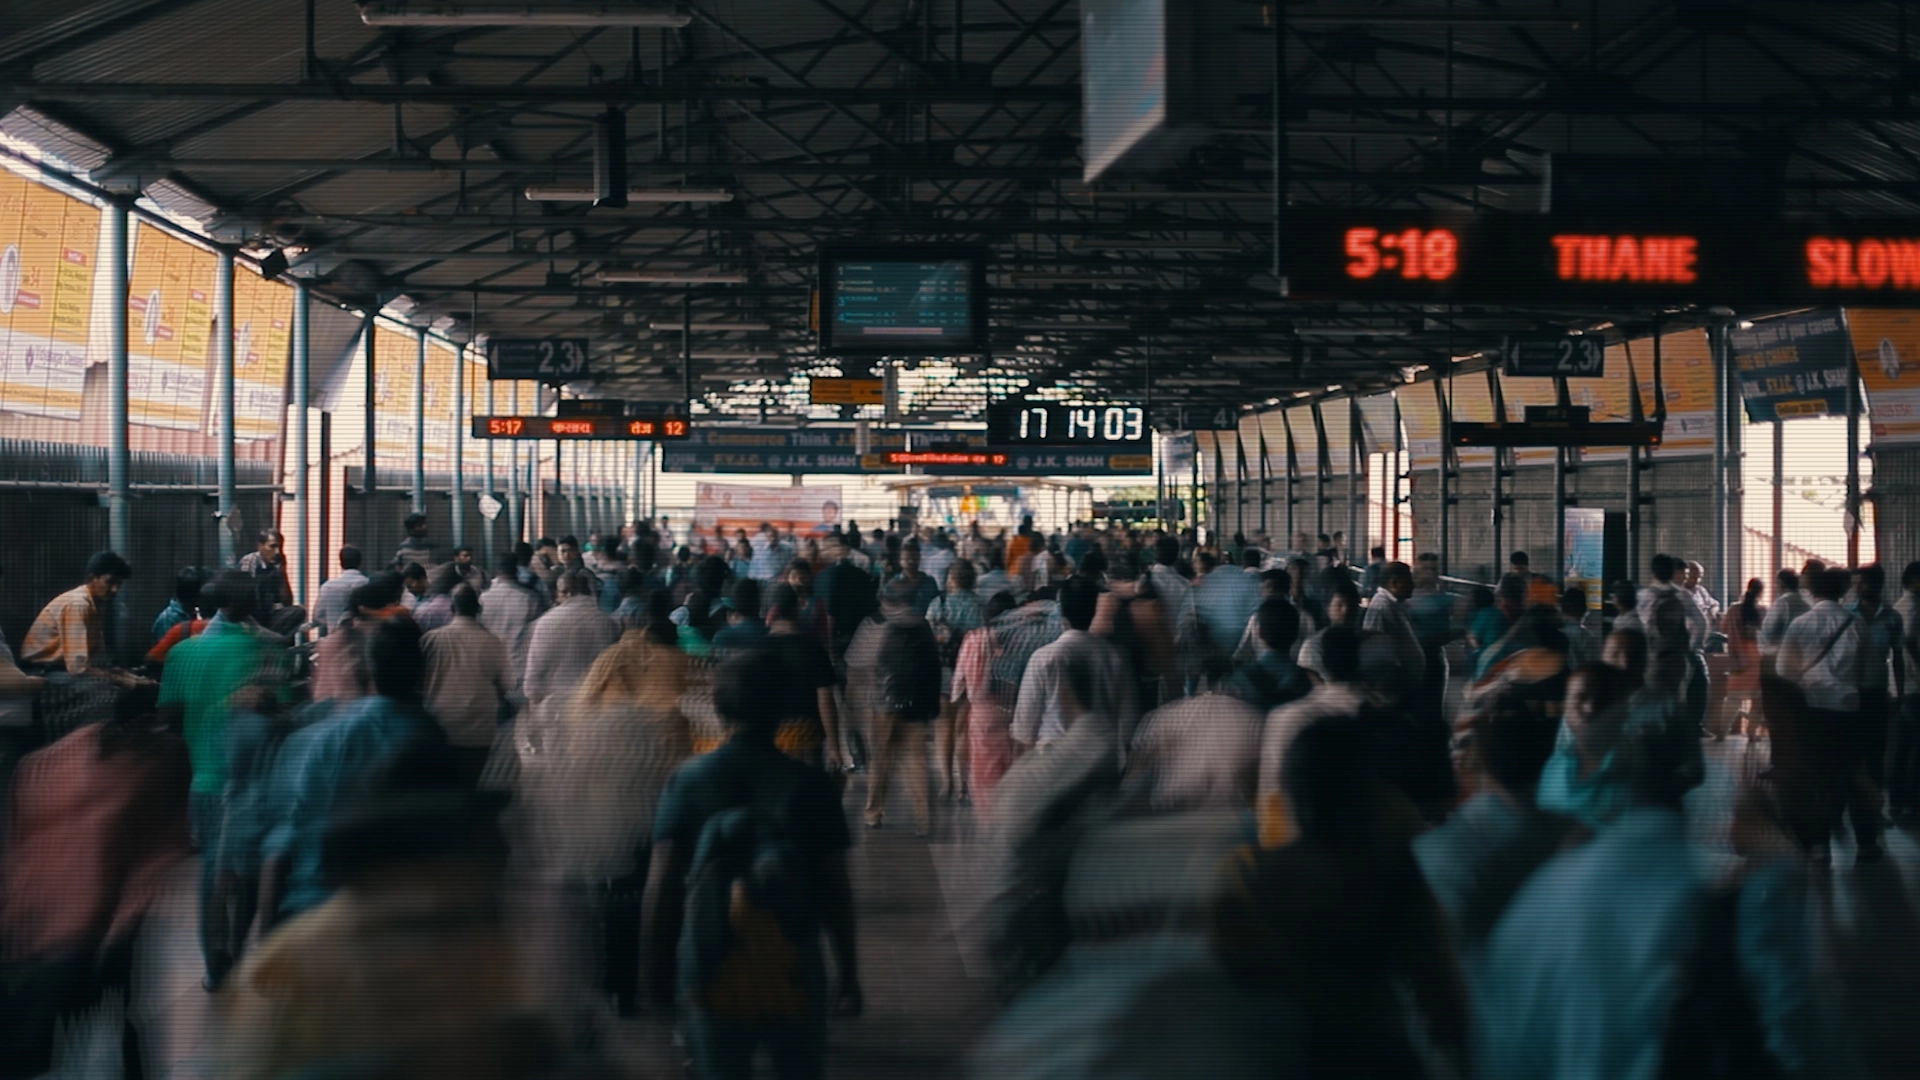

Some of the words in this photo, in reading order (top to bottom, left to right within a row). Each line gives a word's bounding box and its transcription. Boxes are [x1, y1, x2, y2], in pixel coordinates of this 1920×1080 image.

[1345, 227, 1459, 281] 5:18
[1551, 235, 1699, 283] THANE
[1805, 235, 1920, 290] SLOW
[1557, 338, 1593, 373] 2,3
[490, 420, 523, 434] 5:17
[665, 421, 683, 435] 12
[1019, 407, 1048, 439] 17
[1068, 407, 1096, 439] 14
[1104, 407, 1144, 440] 03
[791, 432, 831, 445] Think
[785, 454, 813, 467] J.K.
[818, 454, 857, 467] SHAH
[1034, 455, 1061, 468] J.K.
[1066, 455, 1104, 468] SHAH
